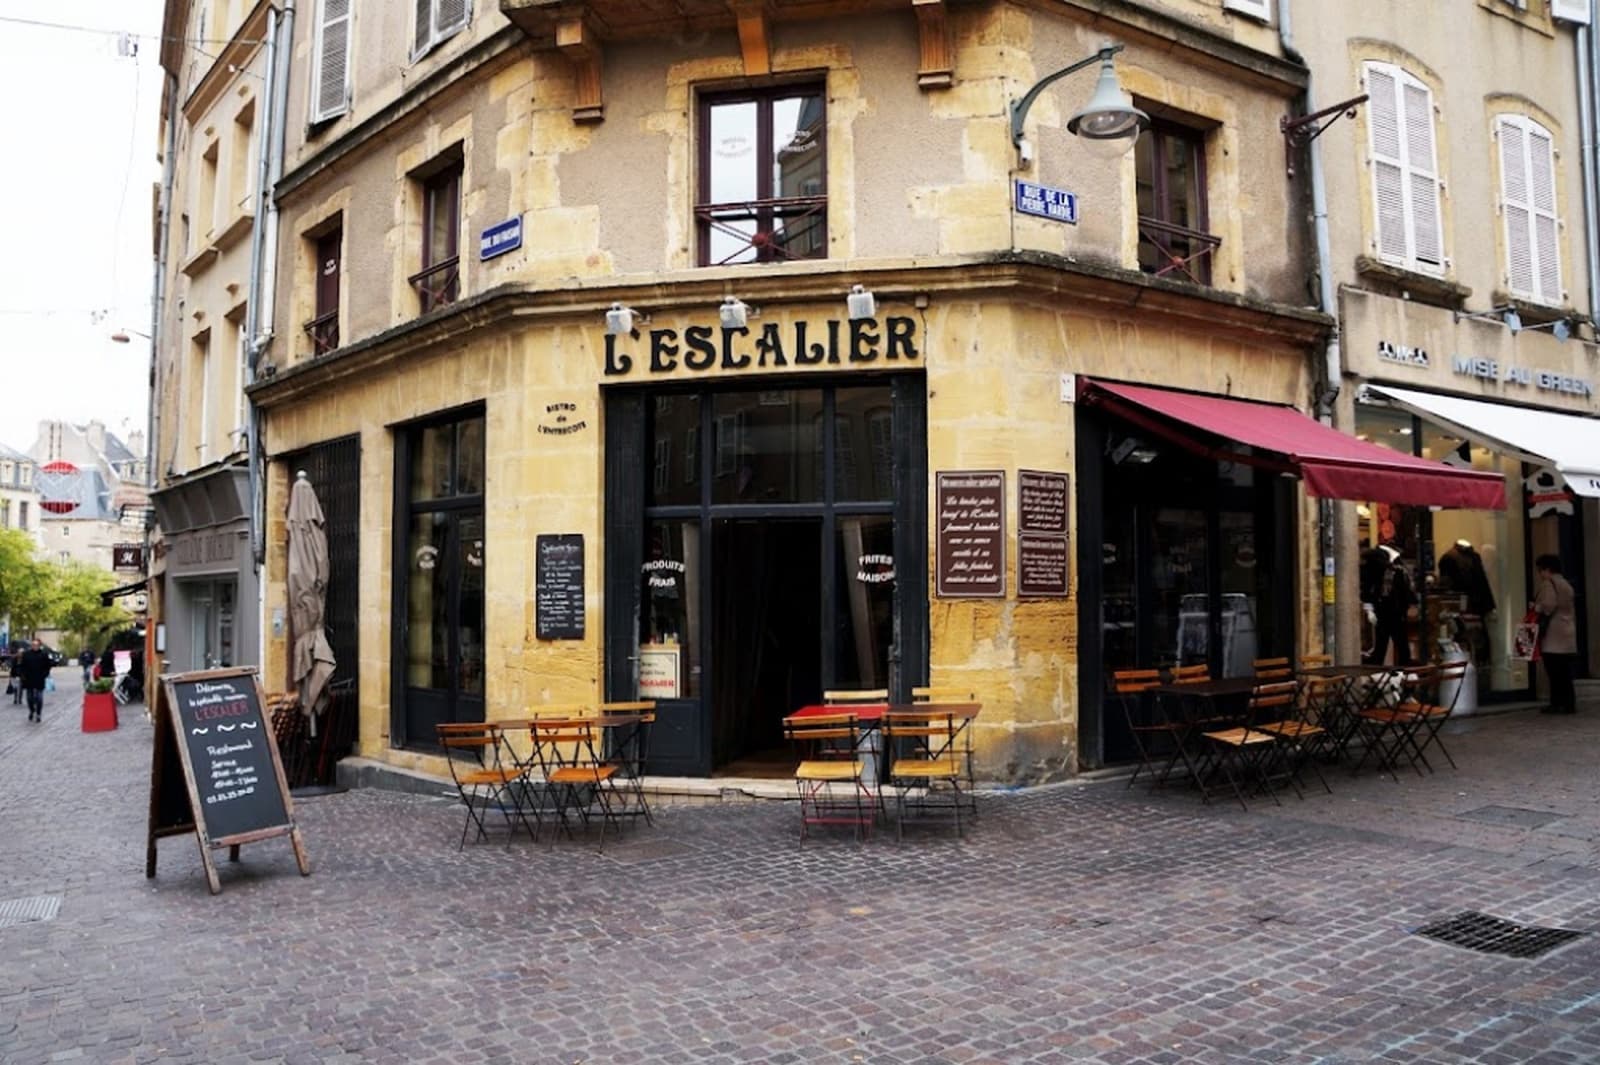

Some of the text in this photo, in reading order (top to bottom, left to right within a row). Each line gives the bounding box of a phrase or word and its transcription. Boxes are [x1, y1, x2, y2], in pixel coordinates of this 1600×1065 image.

[1023, 185, 1070, 207] RUE DE LA
[603, 316, 919, 376] L'ESCALIER
[1453, 354, 1595, 395] MISE AU GREEN
[546, 402, 577, 413] BISTRO
[641, 559, 686, 573] PRODUITS
[858, 554, 893, 566] FRITES
[648, 576, 677, 588] FRAIS
